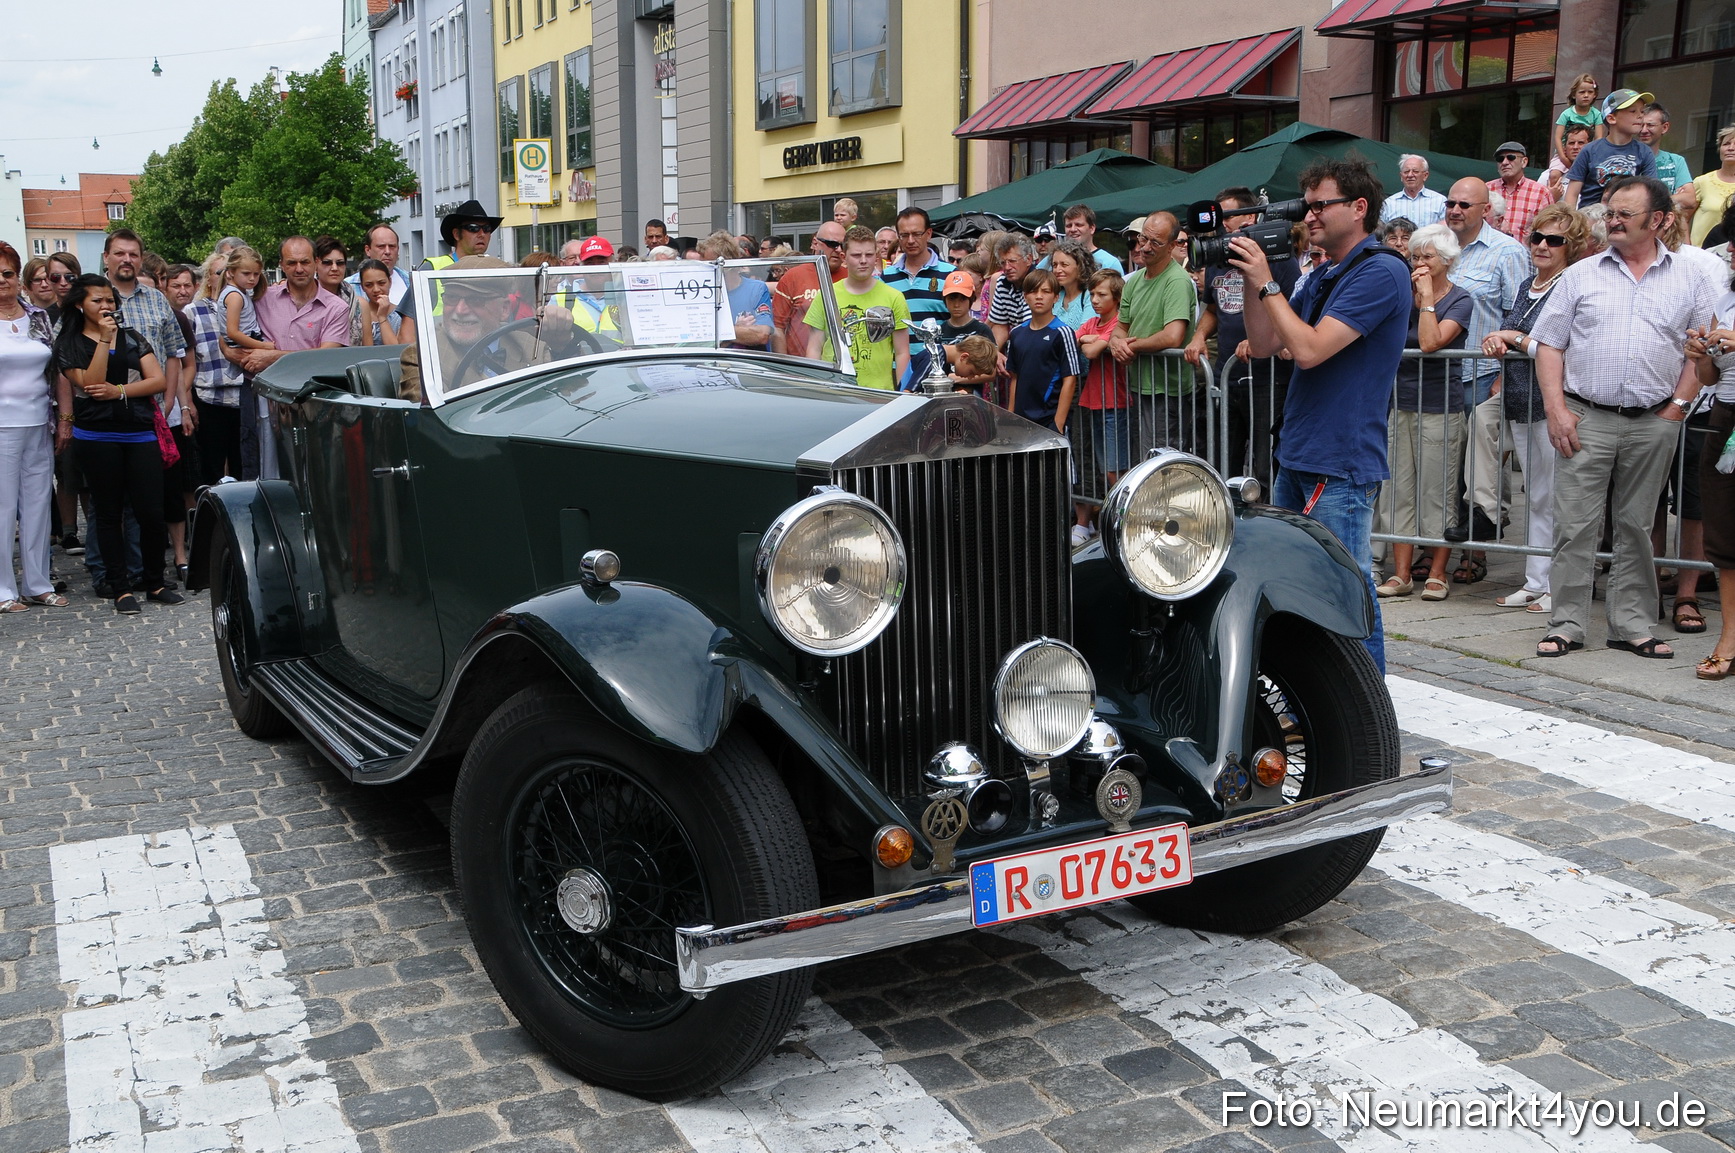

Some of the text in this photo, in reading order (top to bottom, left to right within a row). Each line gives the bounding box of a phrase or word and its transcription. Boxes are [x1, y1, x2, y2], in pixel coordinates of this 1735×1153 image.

[527, 149, 539, 165] H
[783, 136, 862, 170] GERRY WEBER
[674, 278, 714, 300] 495
[928, 801, 962, 838] AA
[1004, 834, 1182, 914] R 07633
[980, 899, 990, 914] D
